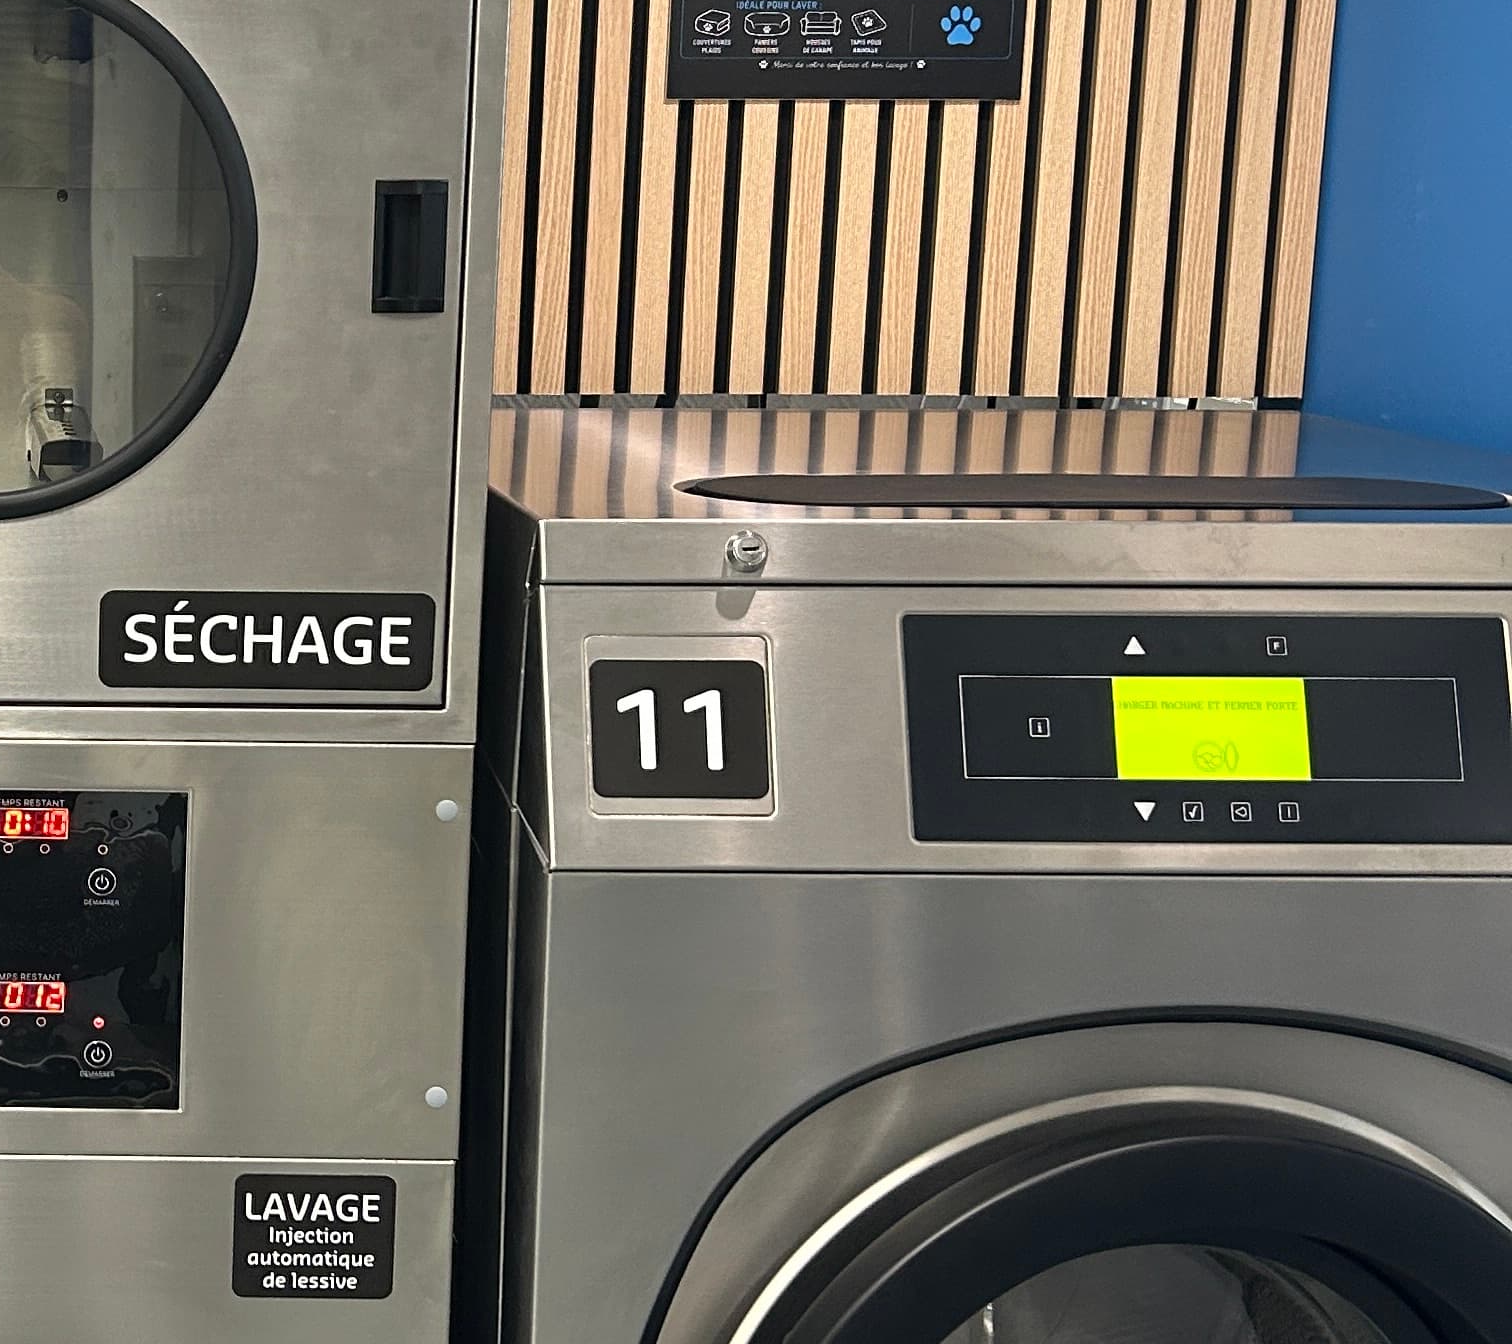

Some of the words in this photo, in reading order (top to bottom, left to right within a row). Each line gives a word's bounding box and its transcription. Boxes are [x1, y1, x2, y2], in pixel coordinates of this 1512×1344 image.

[124, 601, 411, 665] SÉCHAGE
[617, 690, 723, 770] 11
[246, 1193, 380, 1222] LAVAGE
[270, 1227, 353, 1246] Injection
[248, 1250, 374, 1270] automatique
[263, 1272, 286, 1288] de
[291, 1272, 357, 1289] lessive
